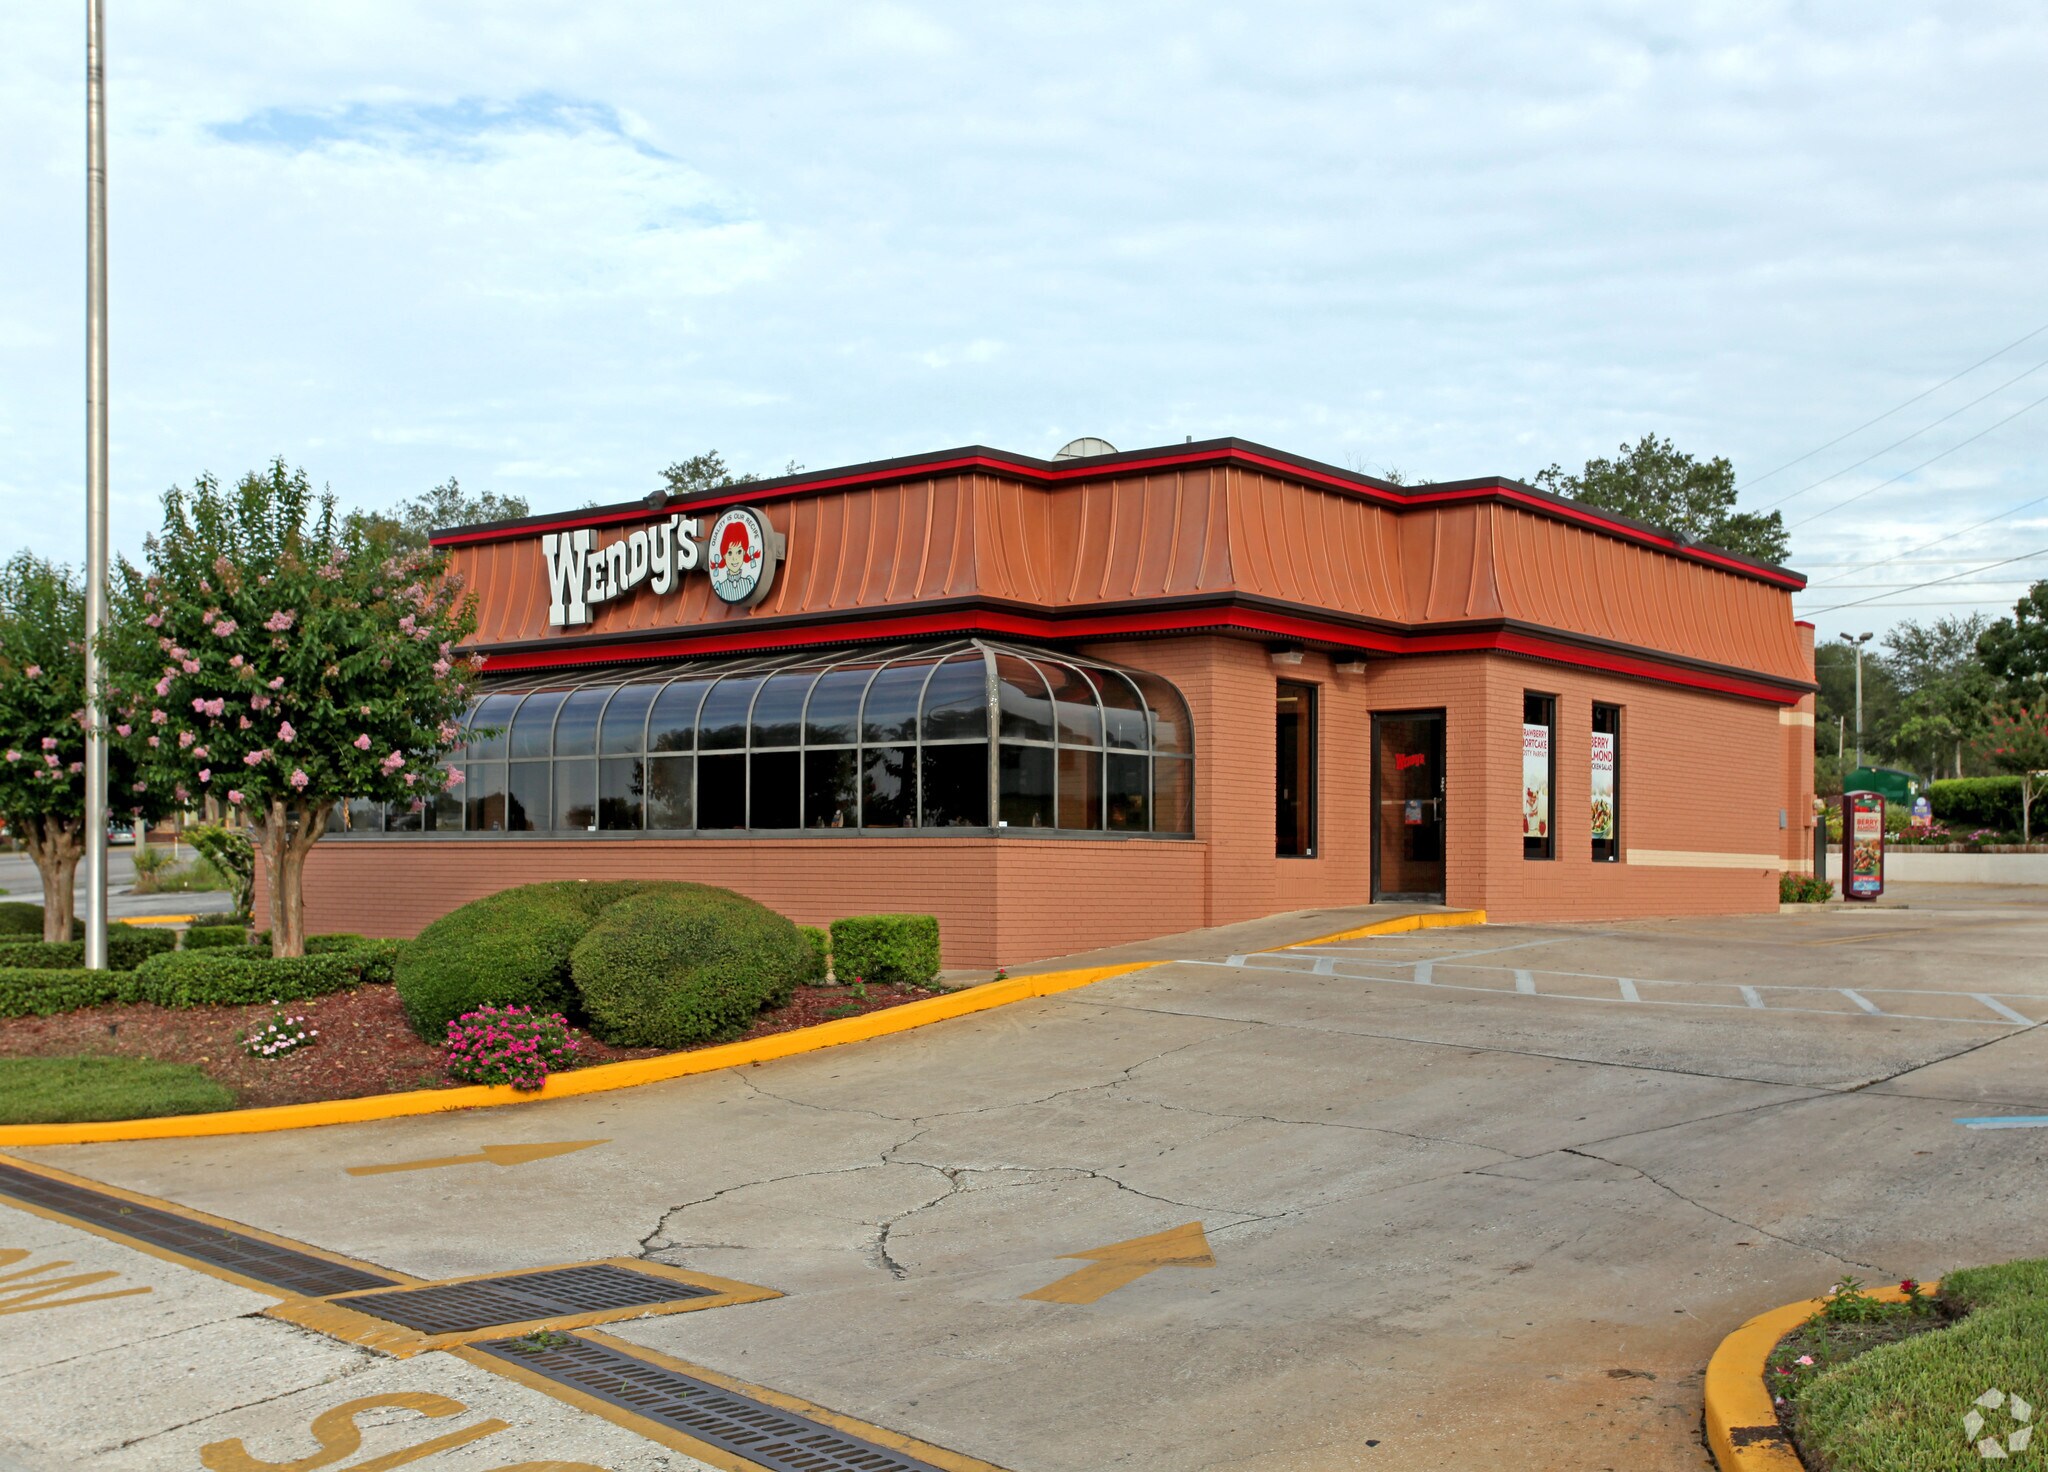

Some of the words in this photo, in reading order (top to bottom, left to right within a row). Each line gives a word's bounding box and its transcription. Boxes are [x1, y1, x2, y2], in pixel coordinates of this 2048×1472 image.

[711, 518, 726, 546] QUALITY
[733, 512, 745, 520] OUR
[745, 517, 760, 540] RECIPE
[1591, 736, 1609, 749] BERRY
